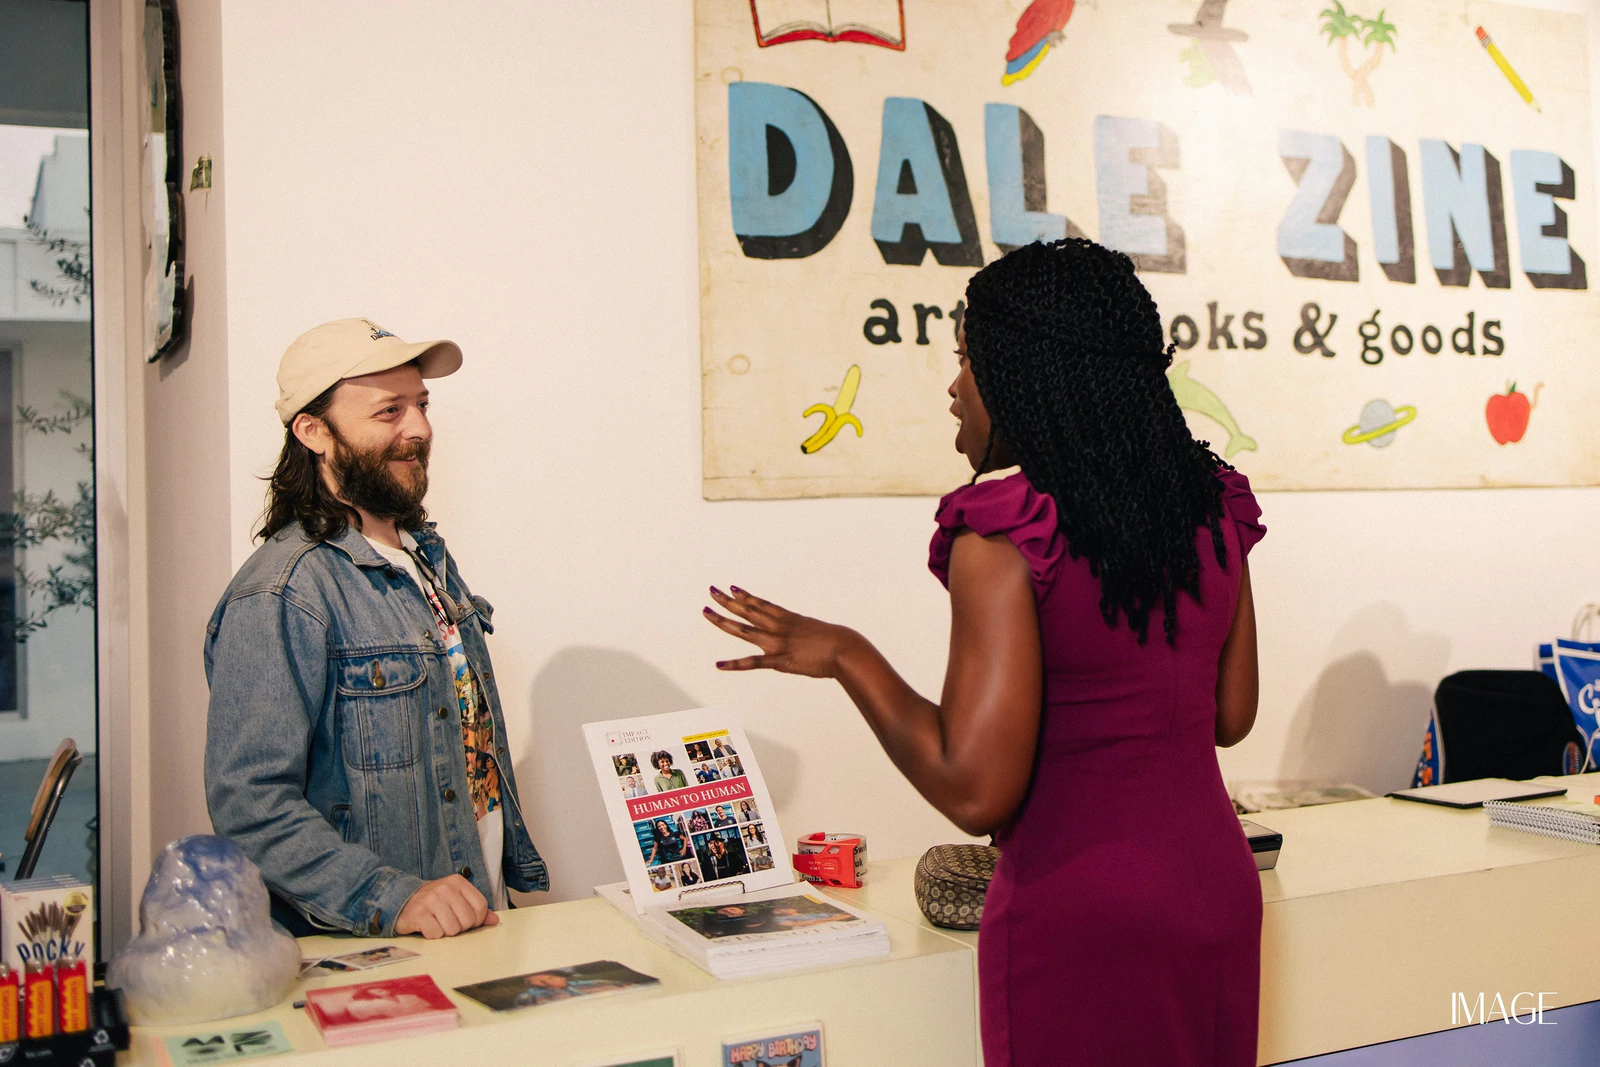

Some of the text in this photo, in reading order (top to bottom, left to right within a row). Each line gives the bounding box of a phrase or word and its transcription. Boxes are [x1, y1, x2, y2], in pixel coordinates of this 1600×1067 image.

[728, 81, 1588, 290] DALE ZINE
[1170, 301, 1267, 350] oks
[1294, 302, 1337, 357] &
[1359, 309, 1505, 366] goods
[622, 729, 649, 738] IMPACT
[624, 735, 651, 744] EDITION
[633, 783, 746, 815] HUMAN TO HUMAN
[729, 1034, 817, 1064] HAPPY BIRTHDAY
